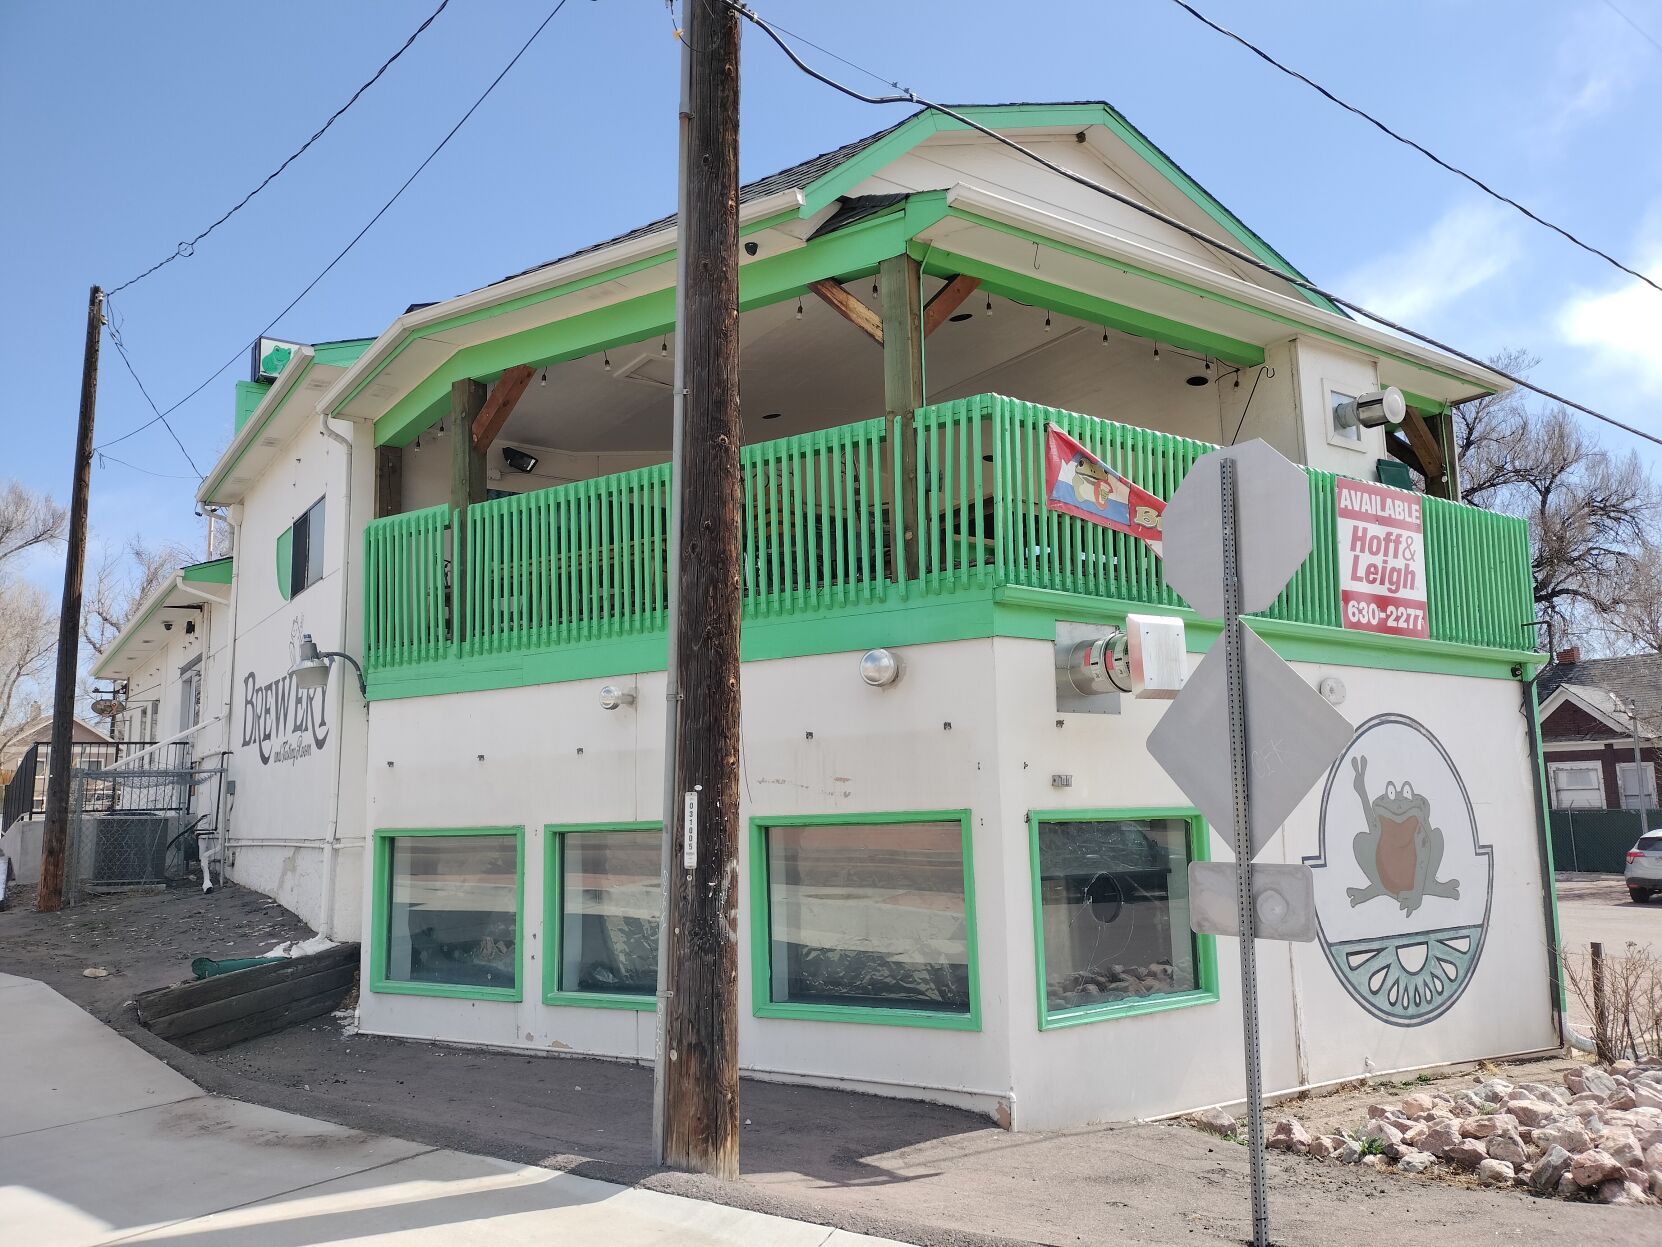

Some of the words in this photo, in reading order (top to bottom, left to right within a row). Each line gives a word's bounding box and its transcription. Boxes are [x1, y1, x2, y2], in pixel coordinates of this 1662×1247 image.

[1340, 488, 1420, 524] AVAILABLE
[1350, 525, 1402, 560] Hoff
[1350, 554, 1416, 594] Leigh
[1347, 600, 1424, 630] 630-2277
